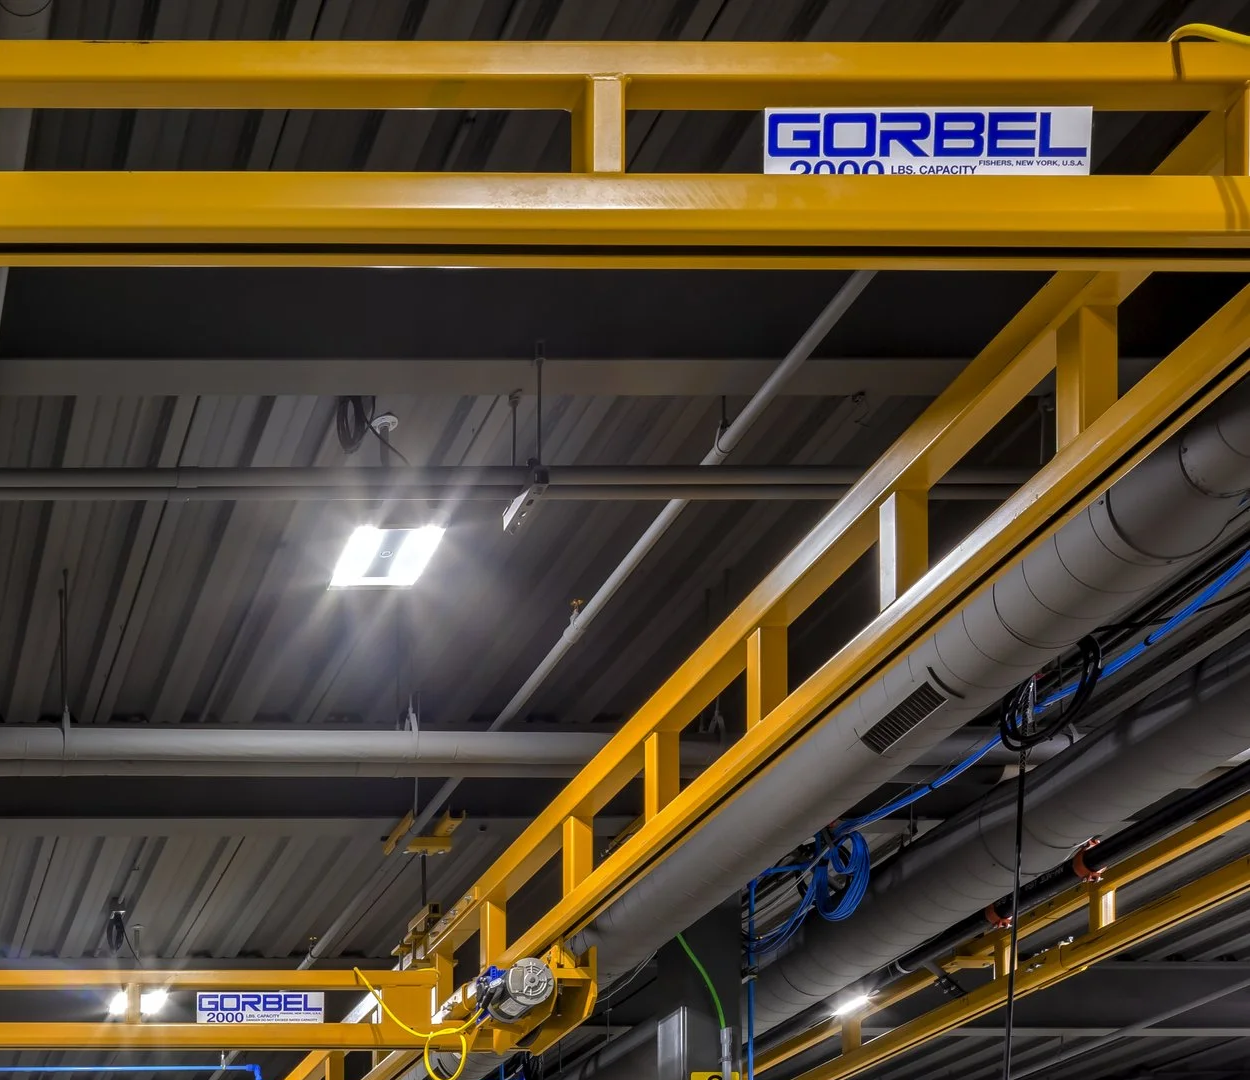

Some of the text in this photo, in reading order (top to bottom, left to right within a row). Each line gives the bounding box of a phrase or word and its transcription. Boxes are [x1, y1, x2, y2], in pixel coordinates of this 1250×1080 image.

[768, 111, 1088, 158] GORBEL
[978, 159, 1085, 167] FISHERS, NEW YORK, U.S.A.
[890, 165, 917, 175] LBS.
[919, 165, 978, 175] CAPACITY
[198, 993, 323, 1012] GORBEL
[206, 1012, 244, 1023] 2000
